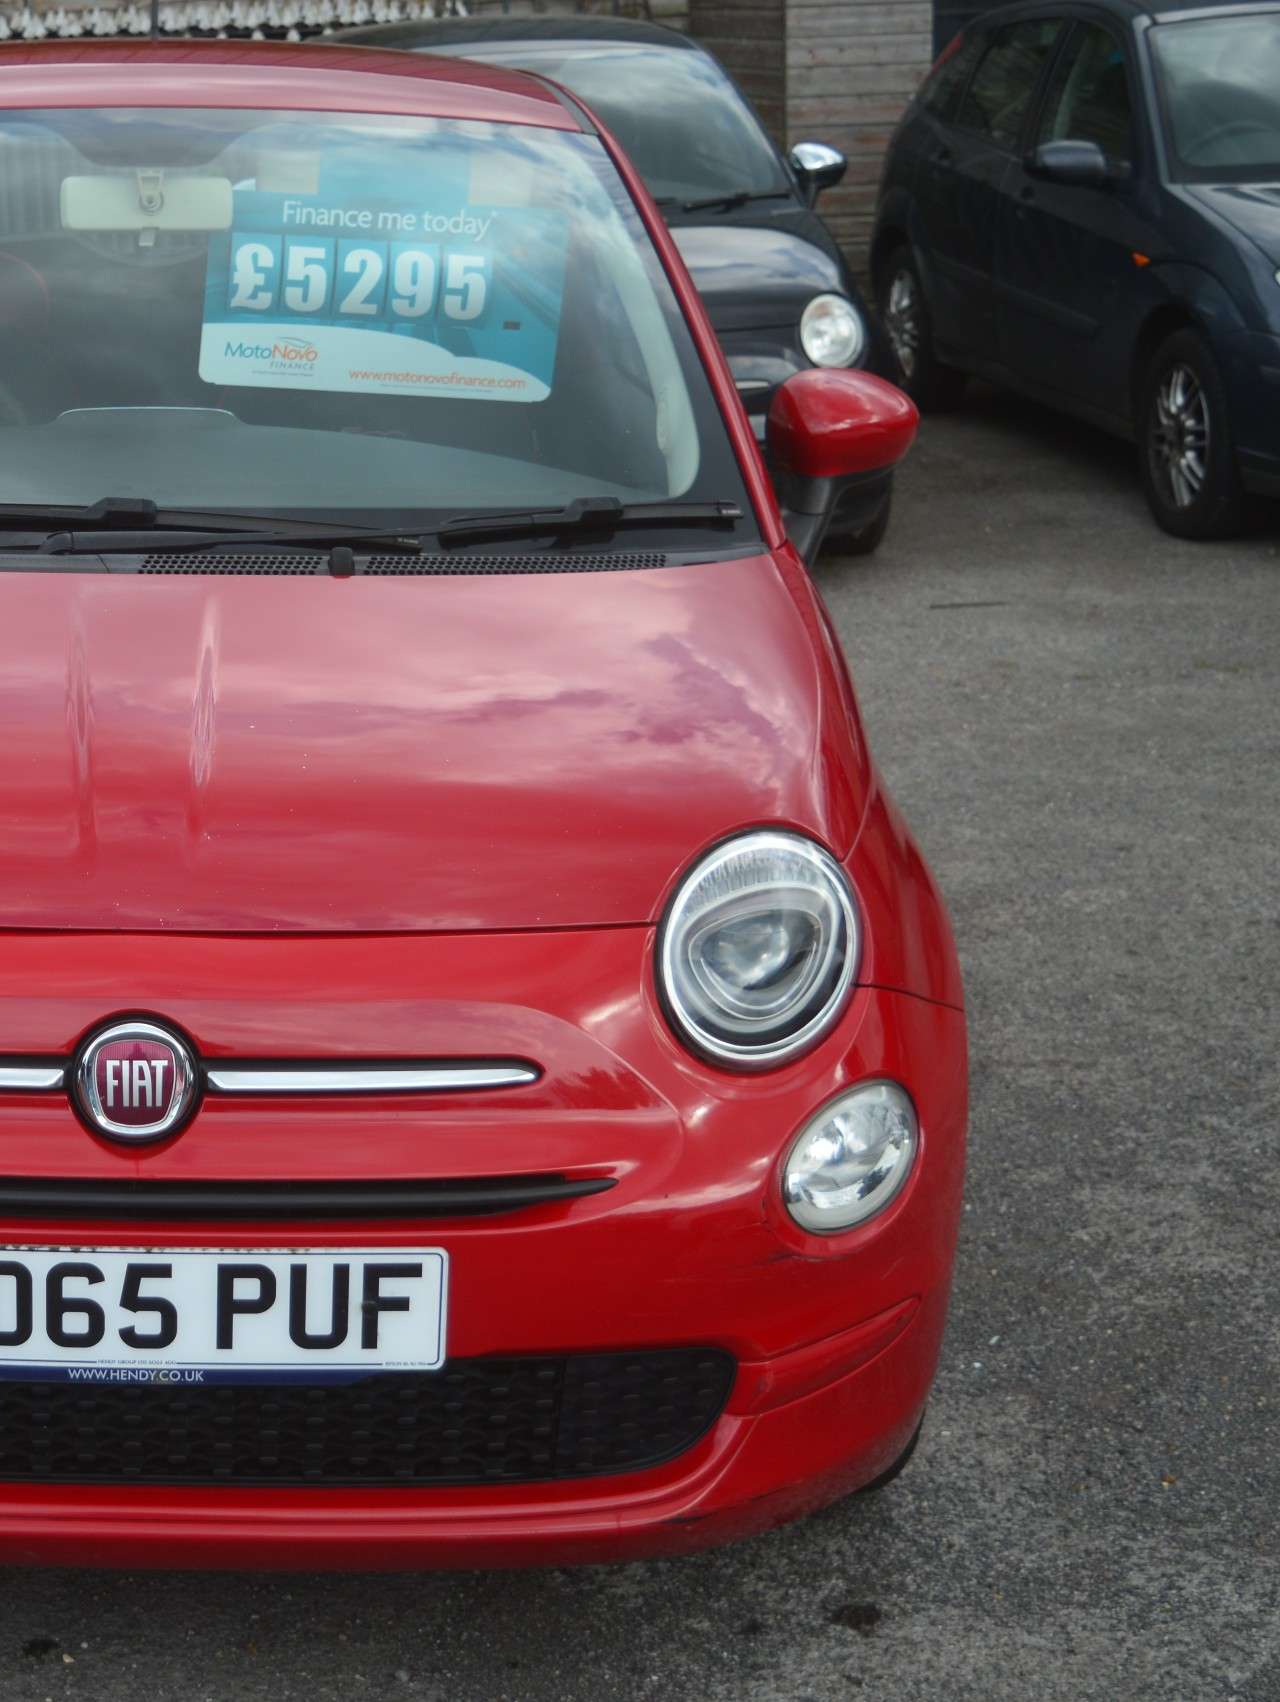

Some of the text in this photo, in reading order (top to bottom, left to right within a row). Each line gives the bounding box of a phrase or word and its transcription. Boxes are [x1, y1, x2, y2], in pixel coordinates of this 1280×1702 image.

[282, 200, 372, 229] Finance
[377, 209, 417, 231] me
[230, 243, 487, 321] £5295
[224, 341, 318, 361] MotoNovo
[349, 368, 526, 390] www.motonovofinance.com
[105, 1059, 169, 1107] FIAT
[216, 1262, 422, 1350] PUF
[68, 1368, 204, 1383] WWW.HENDY.CO.UK
